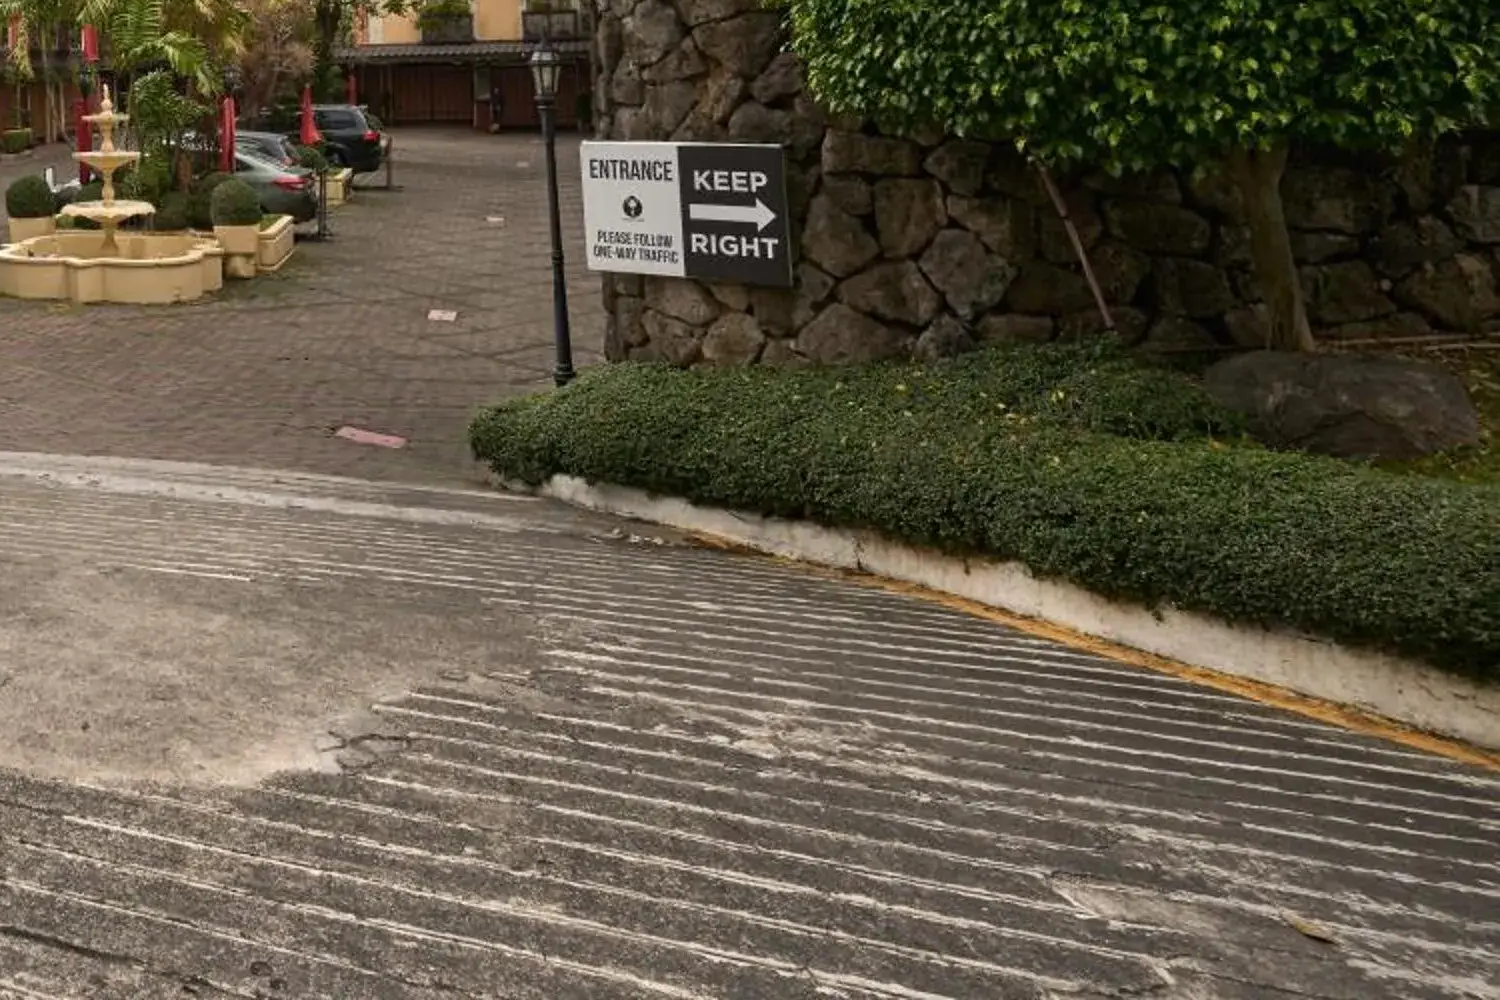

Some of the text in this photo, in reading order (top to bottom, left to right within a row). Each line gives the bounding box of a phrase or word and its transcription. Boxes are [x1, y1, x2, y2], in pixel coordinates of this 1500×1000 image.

[589, 159, 674, 181] ENTRANCE
[693, 170, 768, 193] KEEP
[597, 230, 673, 247] PLEASE FOLLOW
[691, 233, 779, 259] RIGHT
[593, 245, 679, 264] ONE-WAY TRAFFIC
